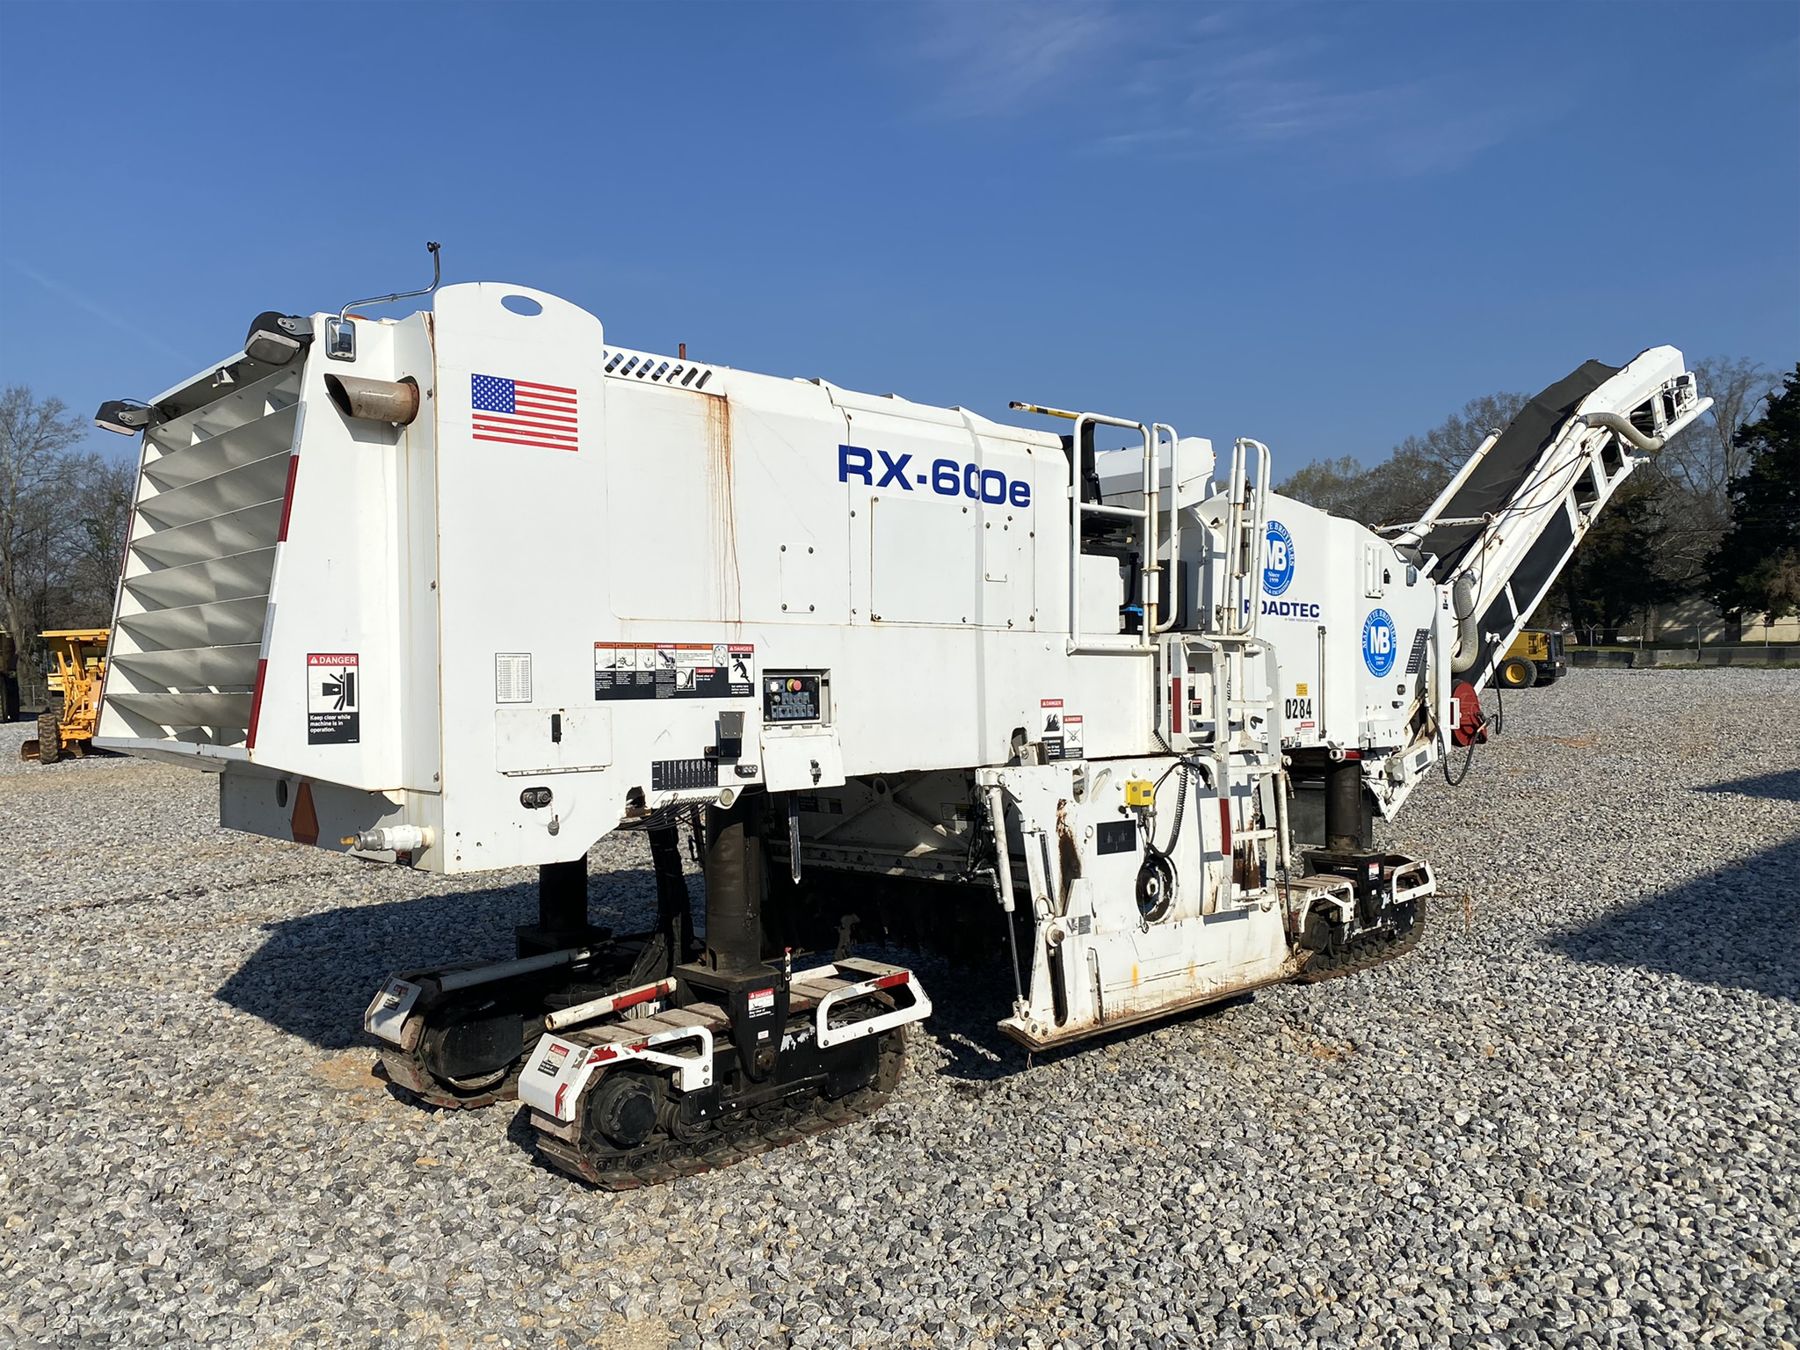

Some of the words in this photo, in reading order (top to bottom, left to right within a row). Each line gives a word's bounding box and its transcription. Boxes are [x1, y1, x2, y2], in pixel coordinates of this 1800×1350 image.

[838, 444, 1031, 508] RX-600e
[1370, 626, 1390, 654] MB
[319, 656, 356, 664] DANGER
[1285, 698, 1312, 719] 0284
